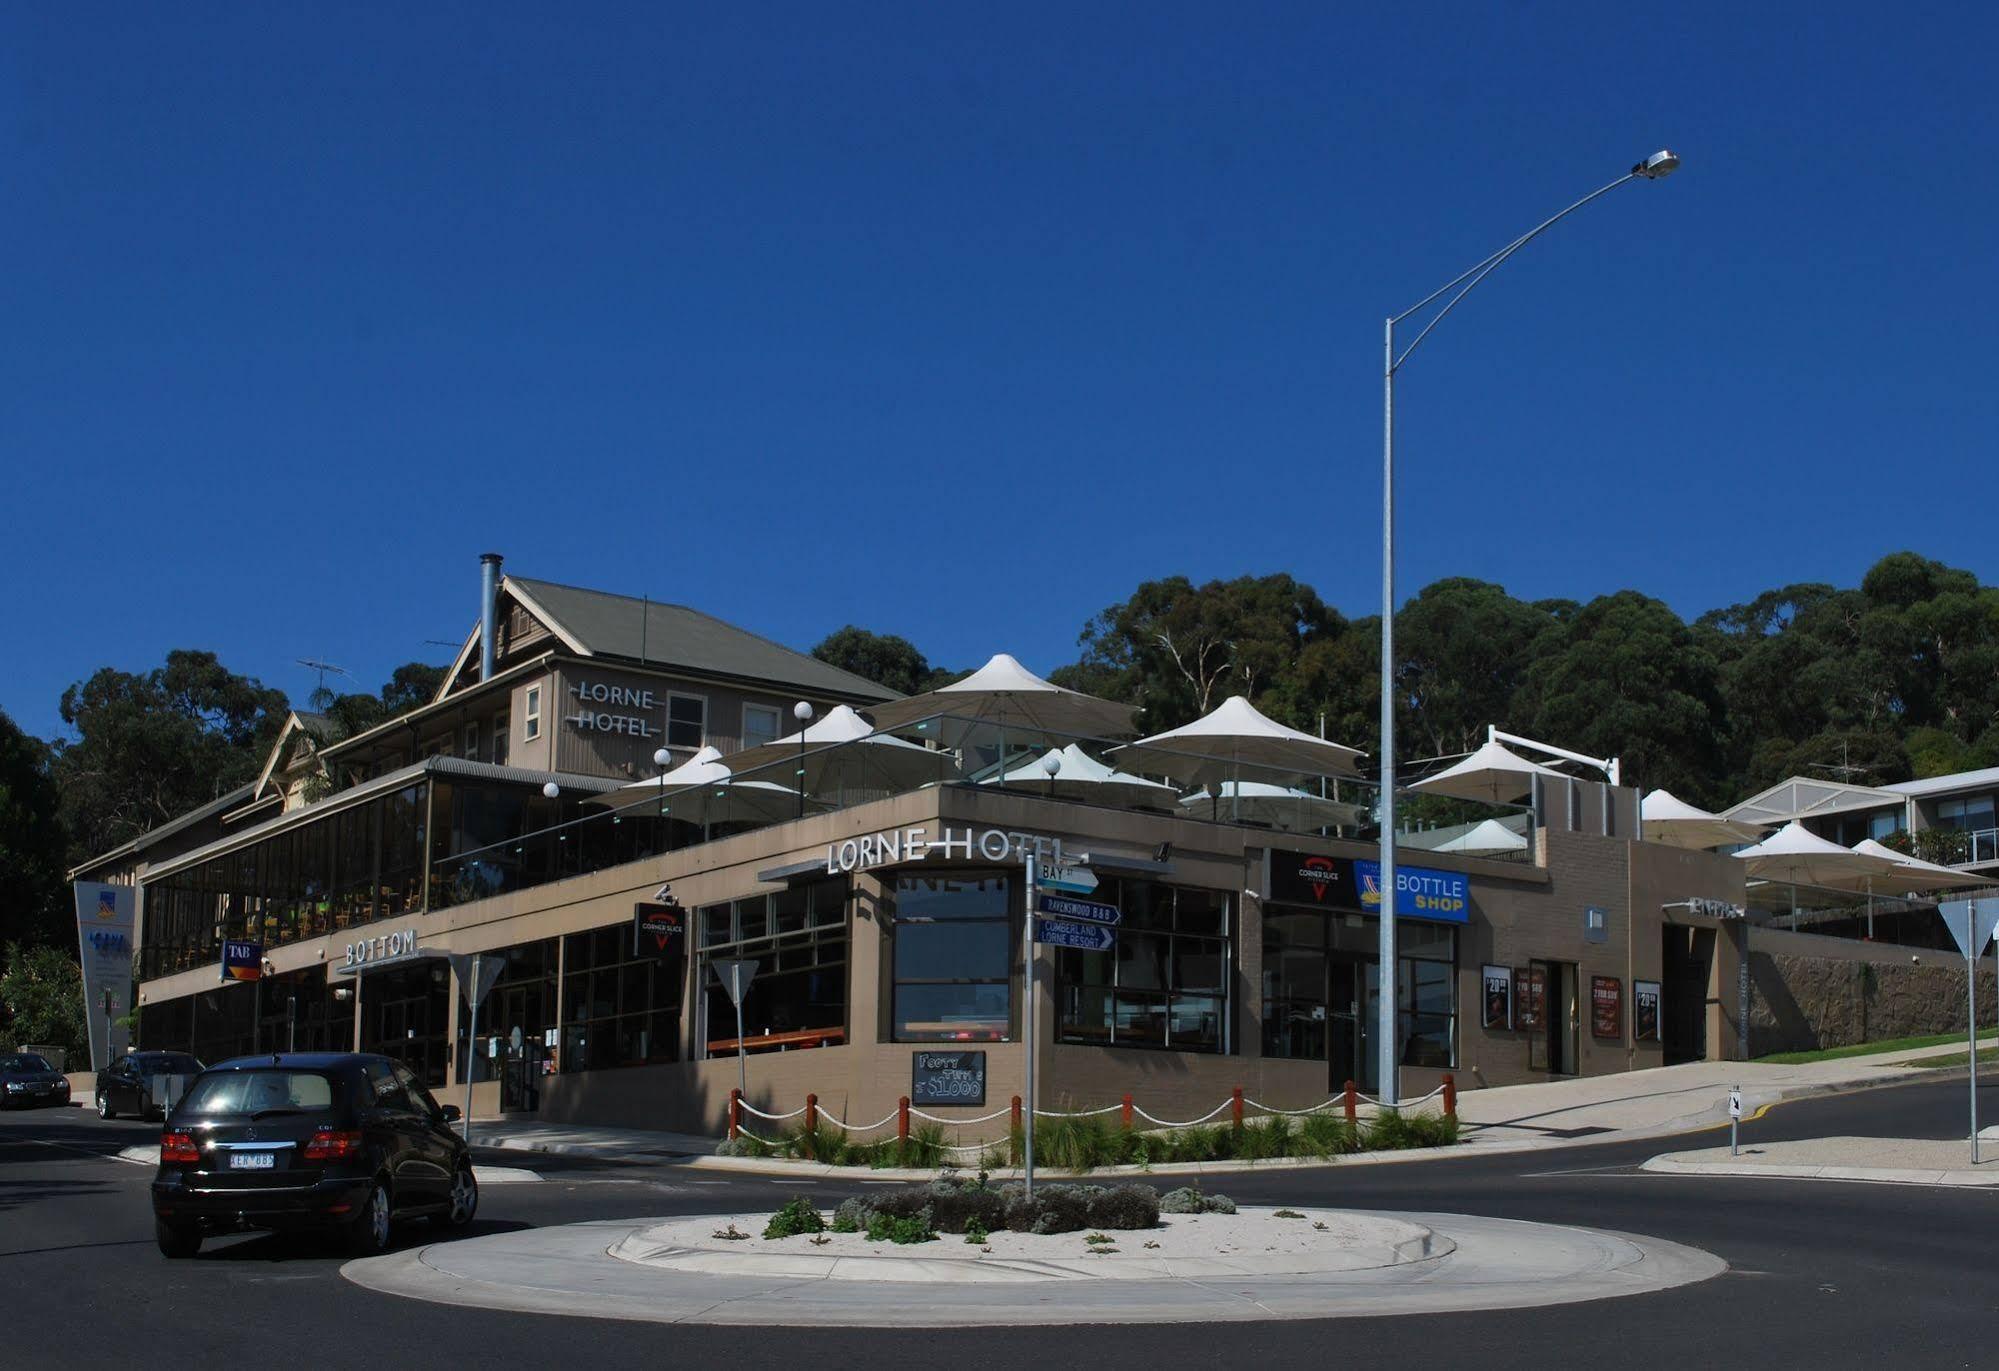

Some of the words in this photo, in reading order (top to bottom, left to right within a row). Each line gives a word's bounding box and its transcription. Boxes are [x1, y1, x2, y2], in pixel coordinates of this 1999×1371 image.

[580, 681, 653, 709] LORNE
[578, 710, 652, 738] HOTEL
[827, 828, 926, 875] LORNE
[1042, 865, 1063, 880] BAY
[1298, 869, 1322, 878] CORNER
[1323, 871, 1339, 880] SLICE
[1396, 874, 1462, 897] BOTTLE
[1047, 898, 1091, 917] RAVENSWOOD
[1415, 895, 1464, 912] SHOP
[1044, 921, 1097, 937] CUMBERLAND
[346, 930, 416, 965] BOTTOM
[1041, 931, 1067, 945] LORNE
[1069, 934, 1099, 948] RESORT
[228, 944, 250, 958] TAB
[927, 1077, 981, 1097] $1000
